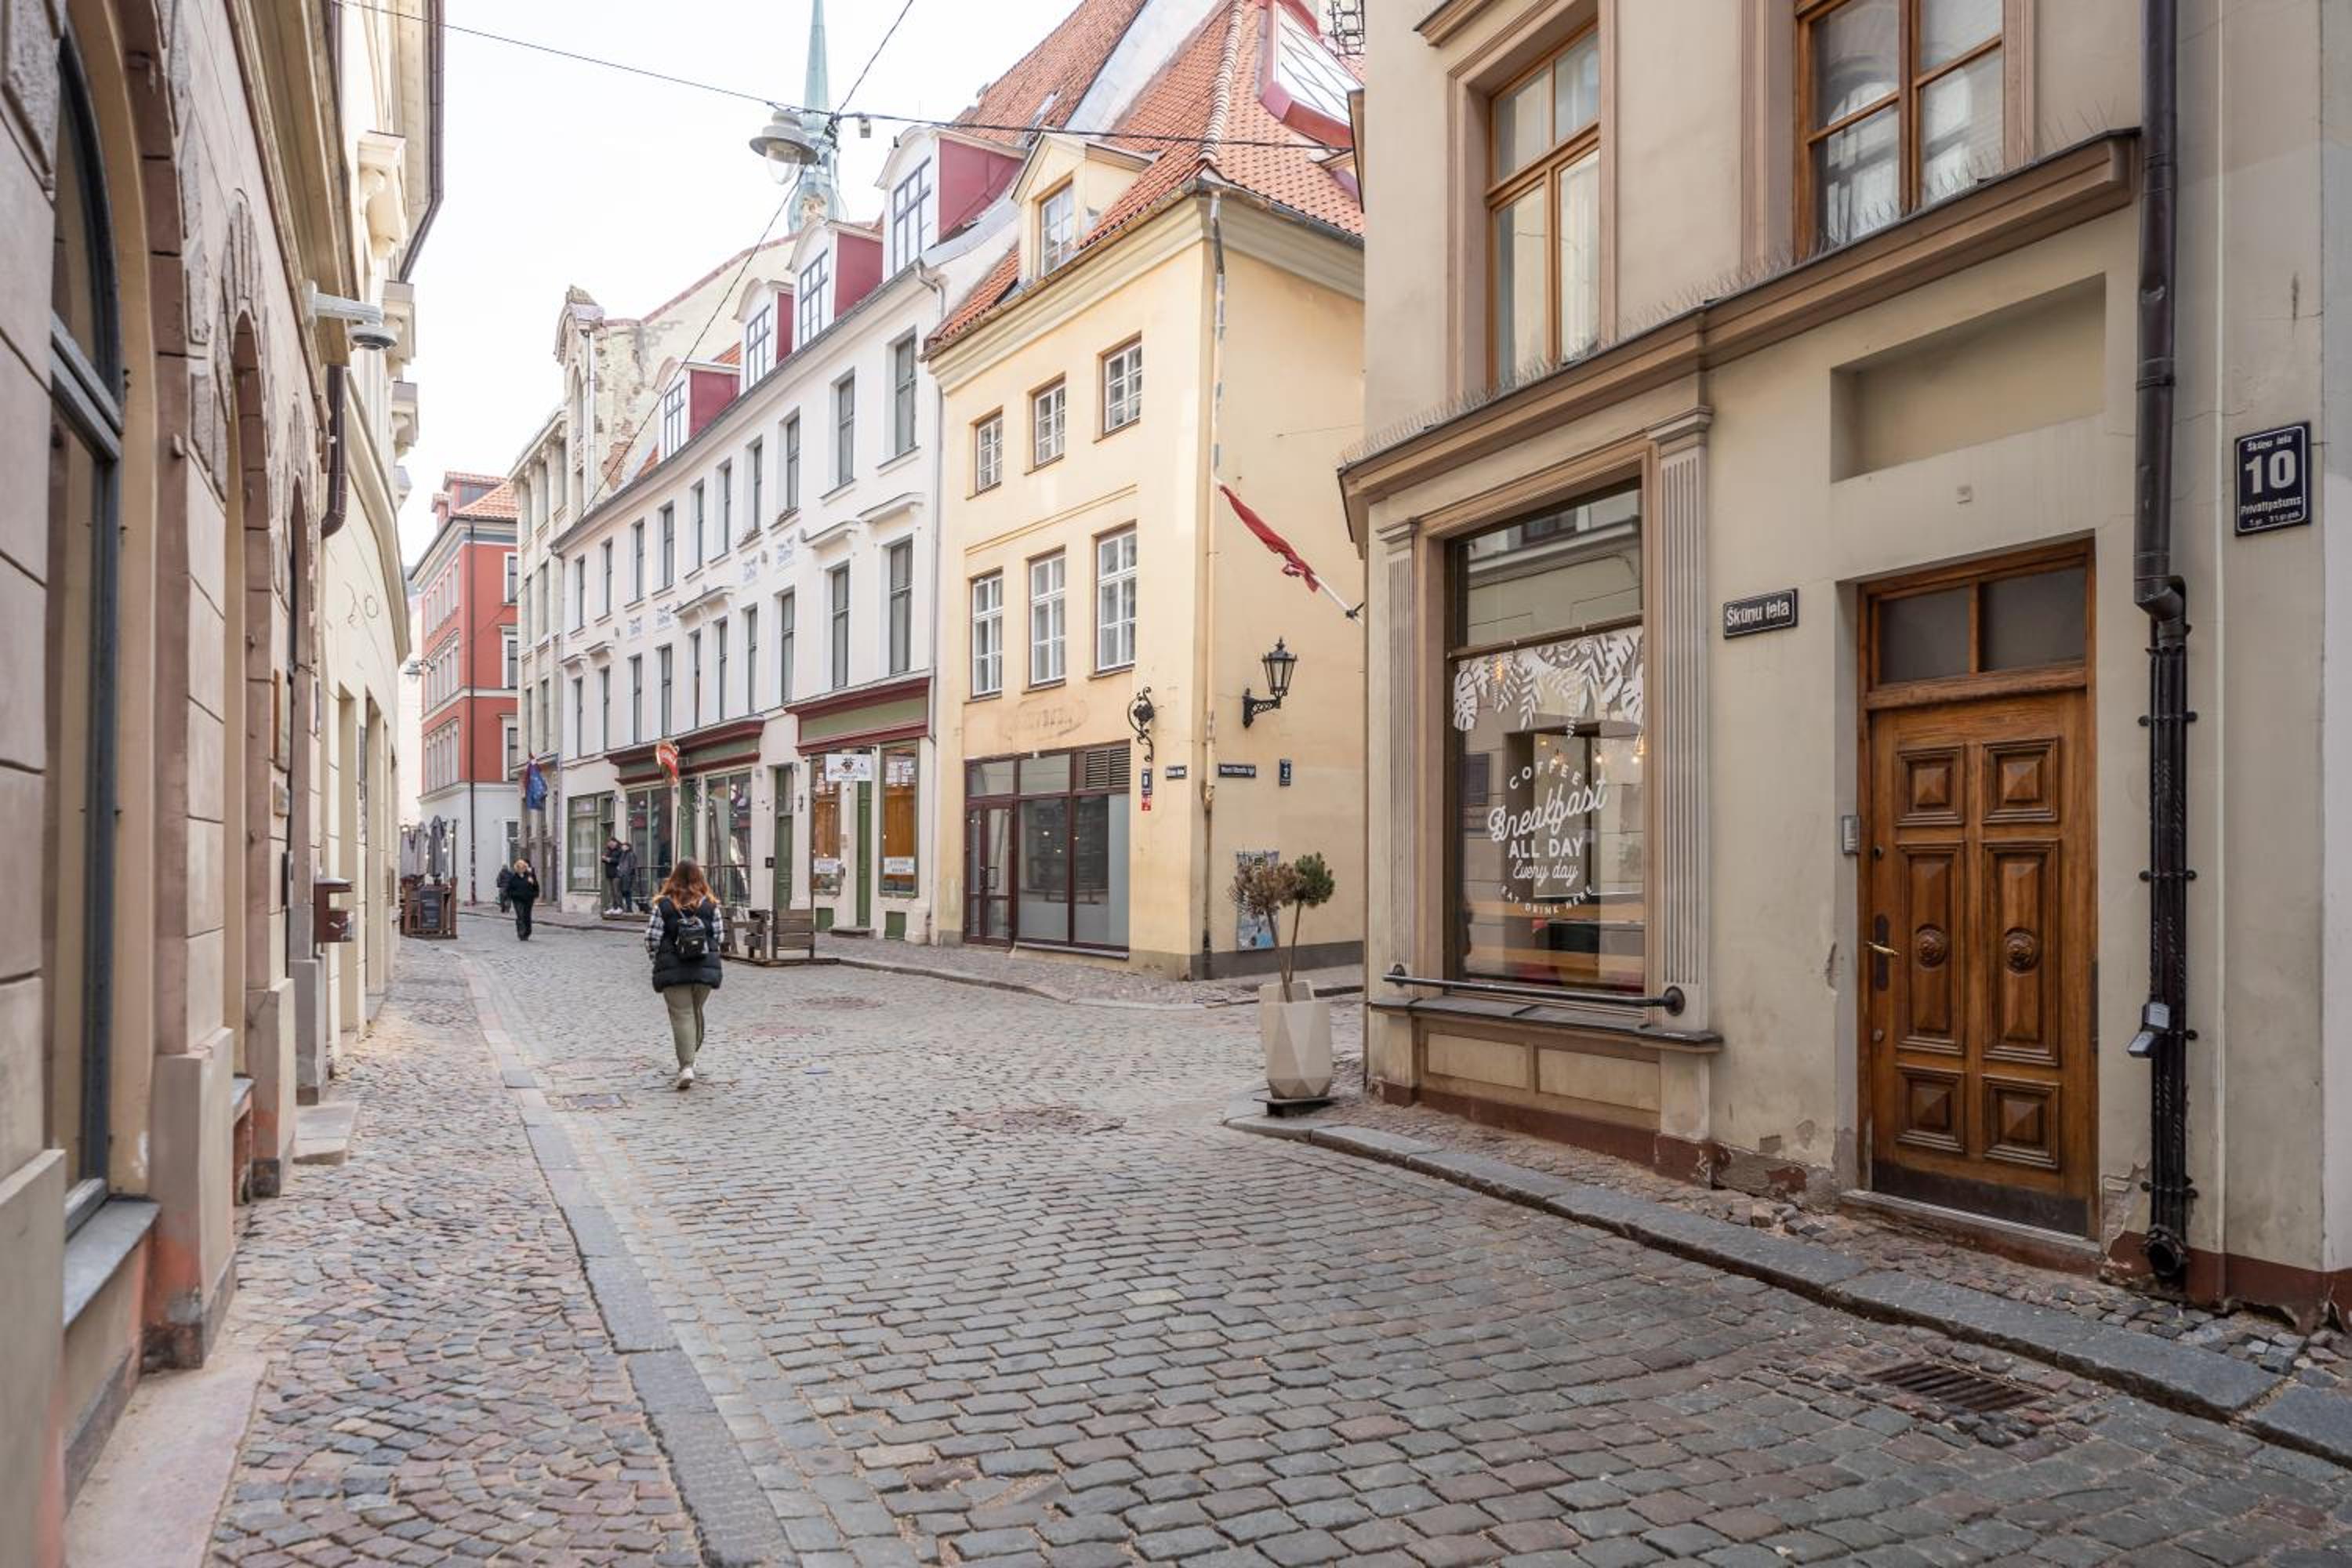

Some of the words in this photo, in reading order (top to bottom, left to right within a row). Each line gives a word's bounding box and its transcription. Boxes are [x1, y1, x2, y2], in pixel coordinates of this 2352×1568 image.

[2245, 449, 2296, 494] 10
[1509, 759, 1582, 789] COFFEE
[1488, 771, 1607, 843] Breakfast
[1508, 840, 1541, 859] ALL
[1548, 836, 1584, 859] DAY
[1512, 859, 1549, 887] Every
[1552, 859, 1579, 887] day
[1525, 902, 1559, 916] DRINK
[1566, 885, 1592, 910] HERE
